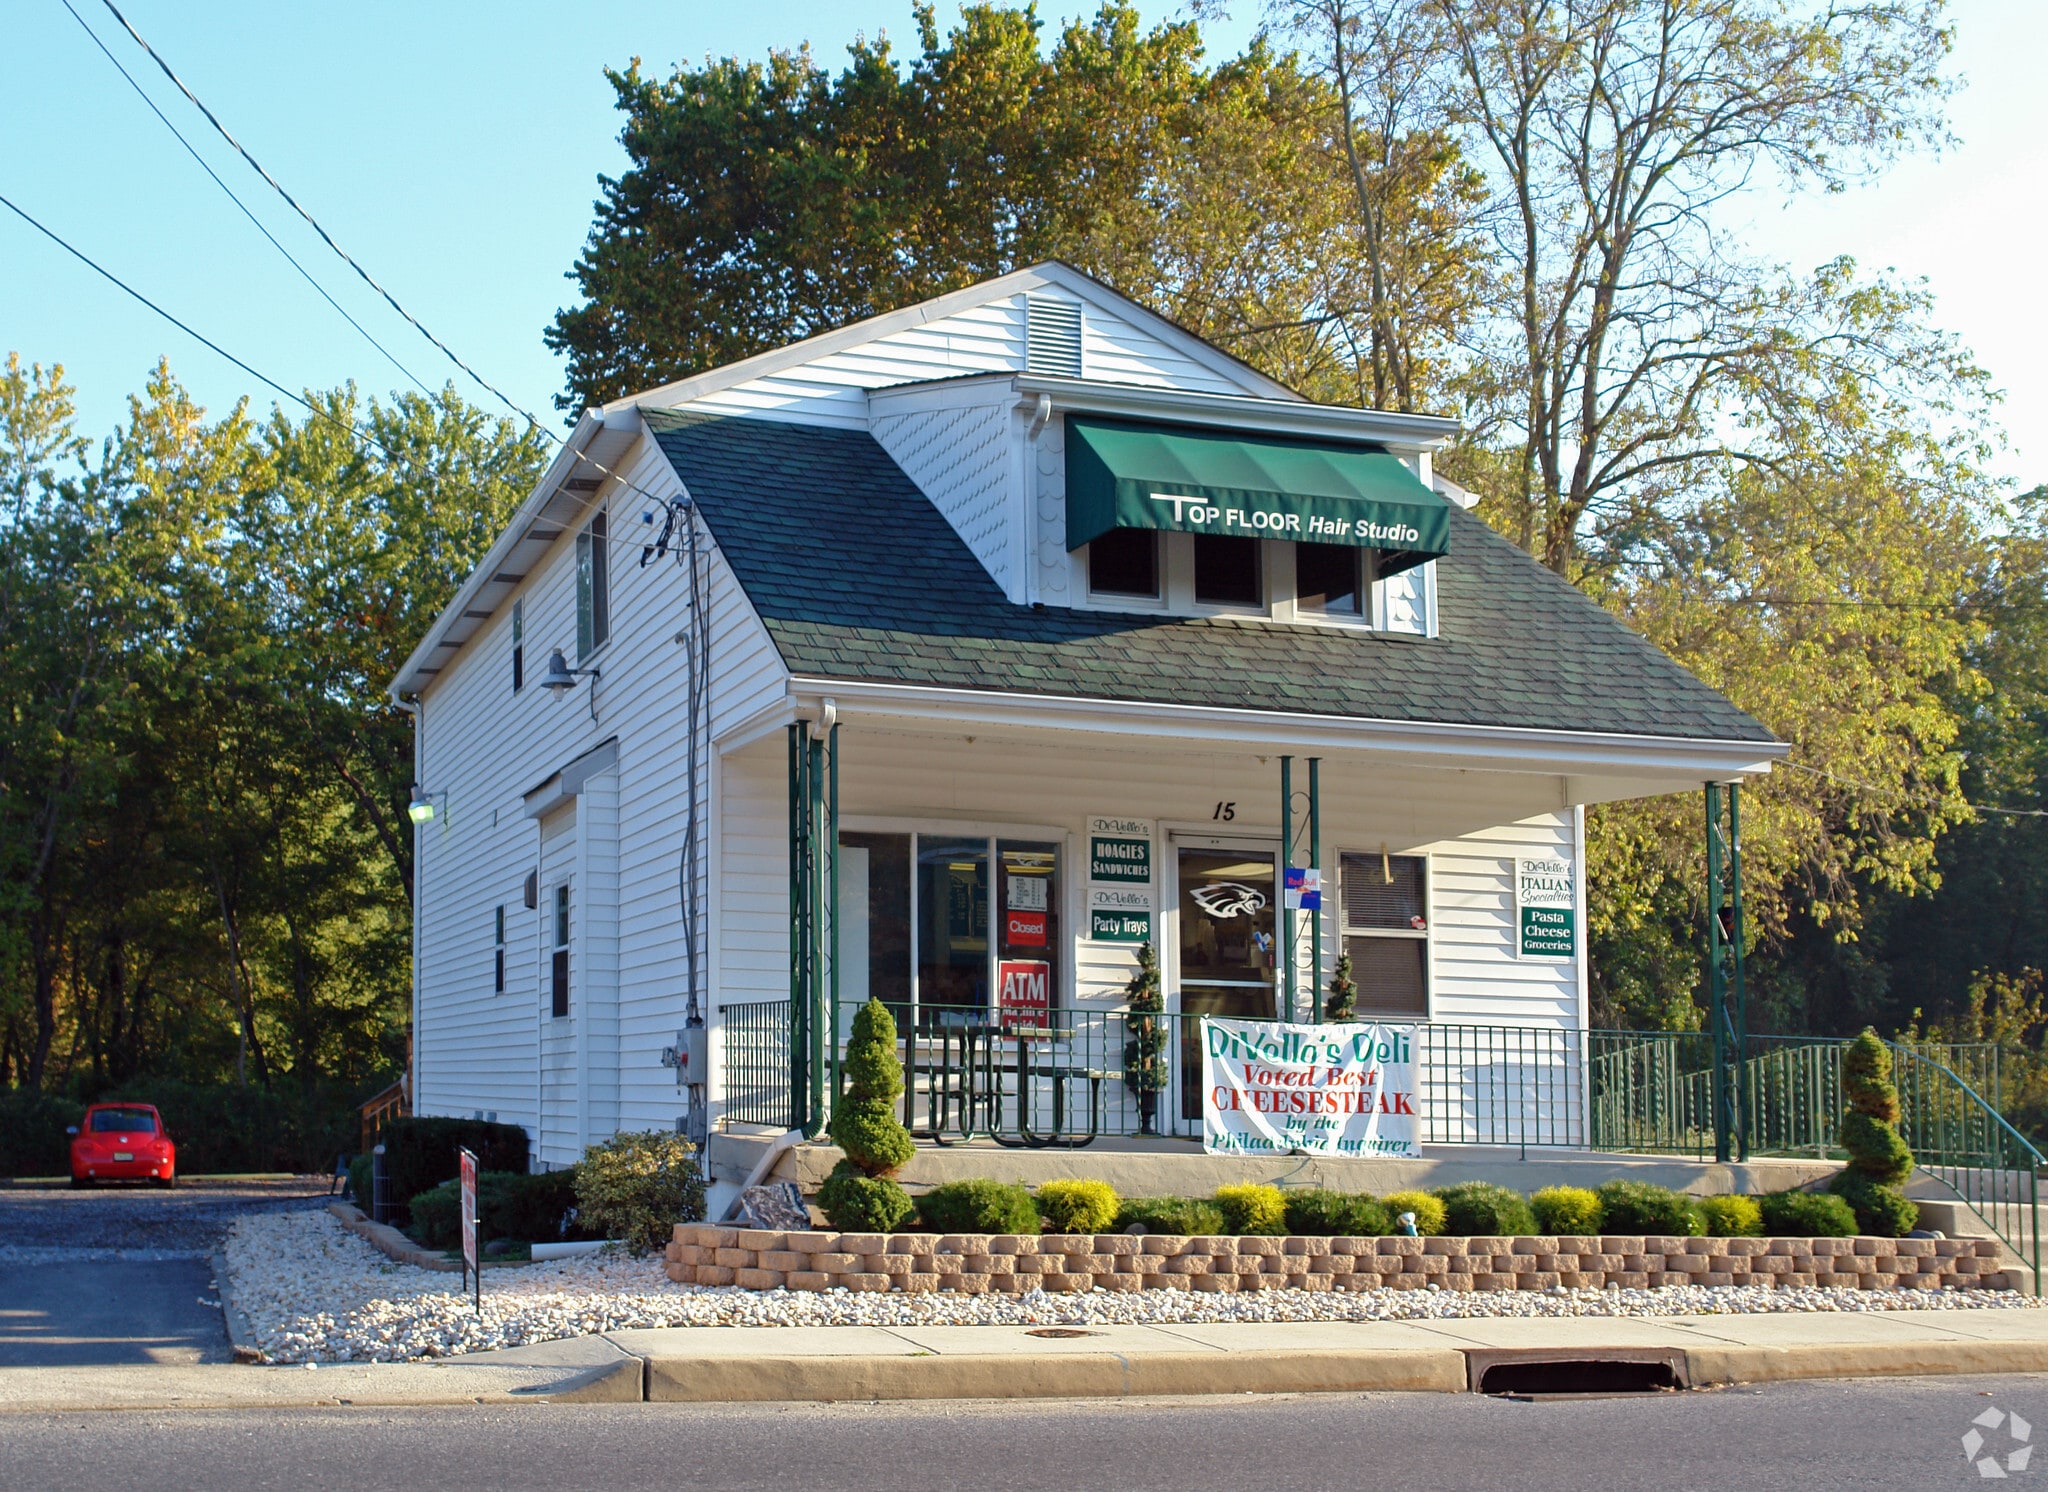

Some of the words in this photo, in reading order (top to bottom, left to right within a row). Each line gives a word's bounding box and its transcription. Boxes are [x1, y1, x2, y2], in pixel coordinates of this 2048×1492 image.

[1226, 508, 1301, 532] FLOOR
[1308, 515, 1350, 535] Hair
[1354, 519, 1419, 542] Studio
[1213, 801, 1235, 821] 15
[1096, 843, 1145, 859] HOAGIES
[1093, 862, 1149, 876] SANDWICHES
[1521, 876, 1574, 891] ITALIAN
[1520, 888, 1574, 904] Specialties
[1531, 911, 1565, 923] Pasta
[1009, 920, 1043, 934] Closed
[1093, 916, 1121, 935] Party
[1122, 917, 1148, 935] Trays
[1525, 925, 1571, 938] Cheese
[1524, 940, 1572, 950] Groceries
[1002, 972, 1045, 1000] ATM
[1352, 1032, 1410, 1064] Deli
[1242, 1064, 1315, 1087] Voted
[1327, 1067, 1379, 1087] Best
[1211, 1085, 1416, 1116] CHEESESTEAK
[1285, 1115, 1307, 1132] by
[1313, 1116, 1339, 1130] the
